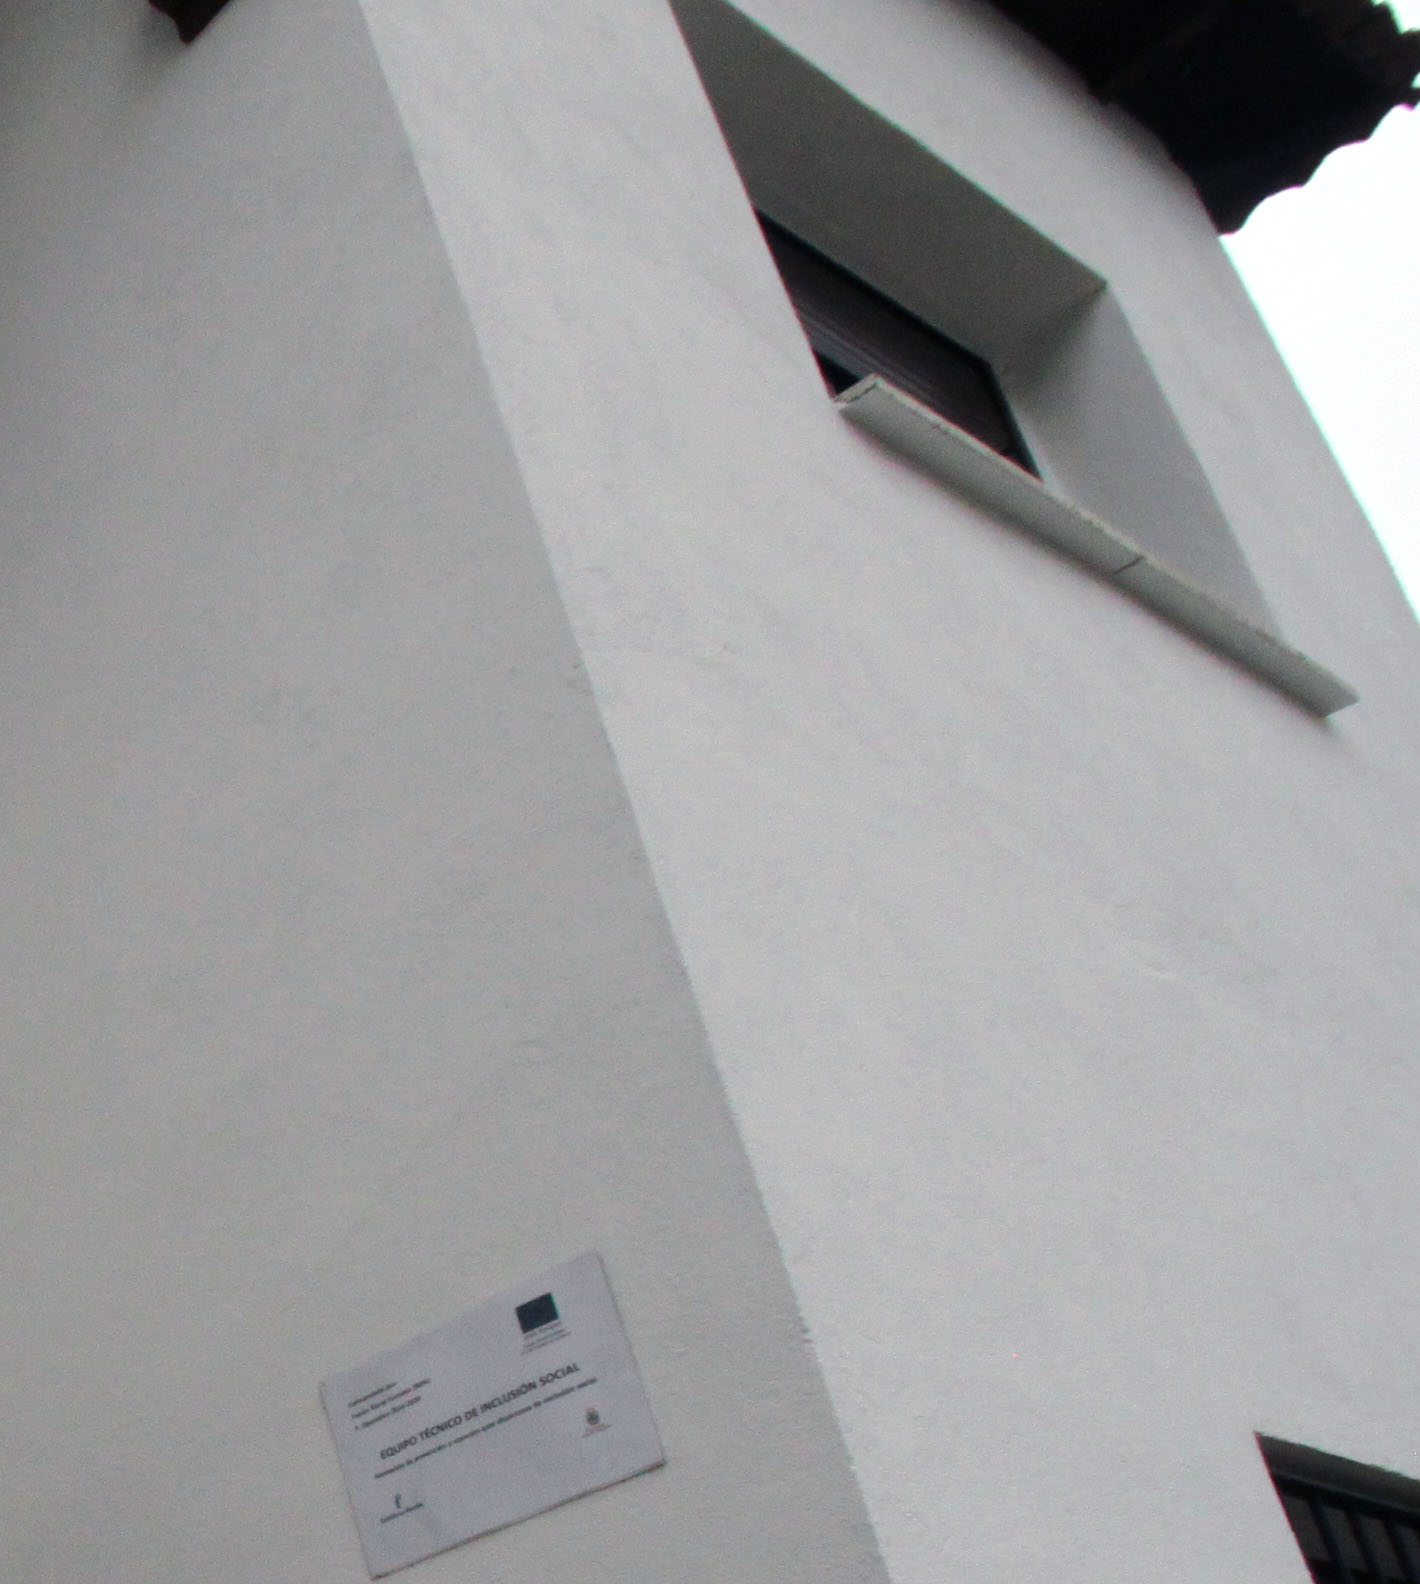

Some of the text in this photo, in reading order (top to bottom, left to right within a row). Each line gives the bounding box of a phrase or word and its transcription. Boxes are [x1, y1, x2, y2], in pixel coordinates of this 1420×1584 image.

[379, 1435, 417, 1460] EQUIPO
[419, 1415, 463, 1441] TÉCNICO
[464, 1407, 479, 1421] DE
[480, 1380, 538, 1414] INCLUSIÓN
[539, 1362, 581, 1387] SOCIAL
